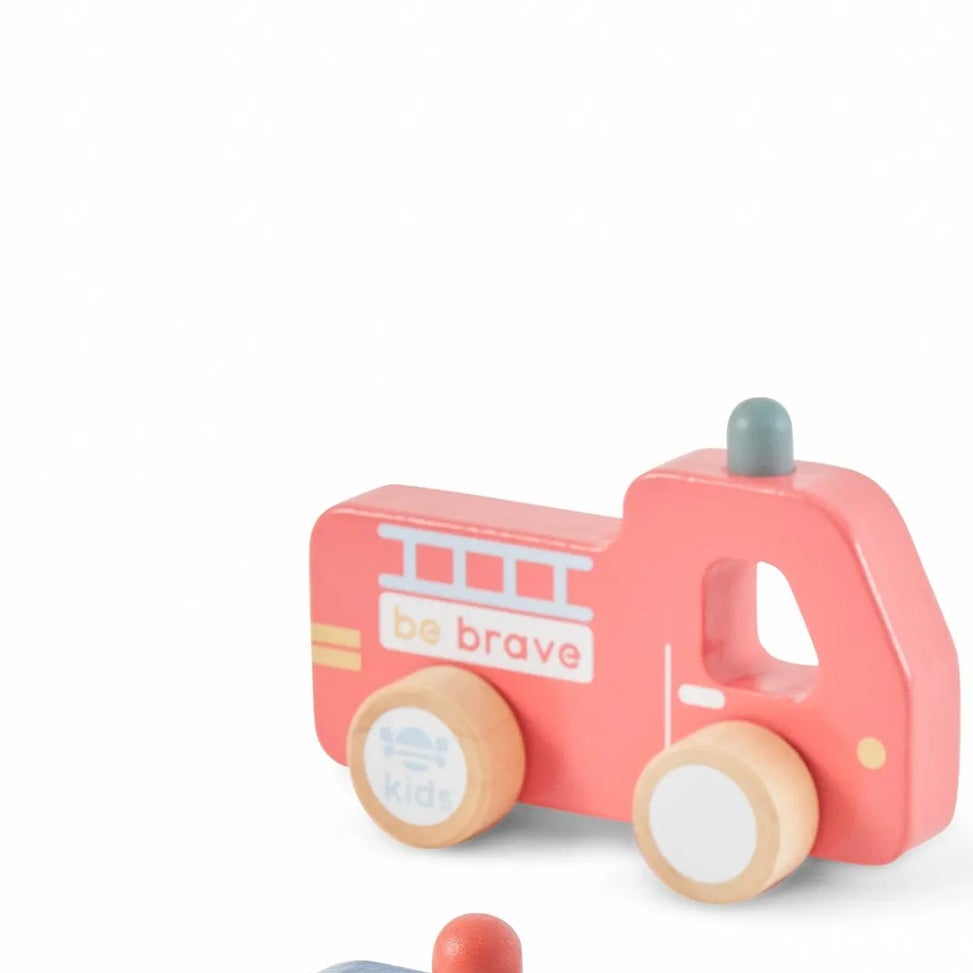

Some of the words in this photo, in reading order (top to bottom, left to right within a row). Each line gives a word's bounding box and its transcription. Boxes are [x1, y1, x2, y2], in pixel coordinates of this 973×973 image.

[392, 605, 440, 646] be
[457, 617, 582, 669] brave
[384, 772, 453, 811] kids
